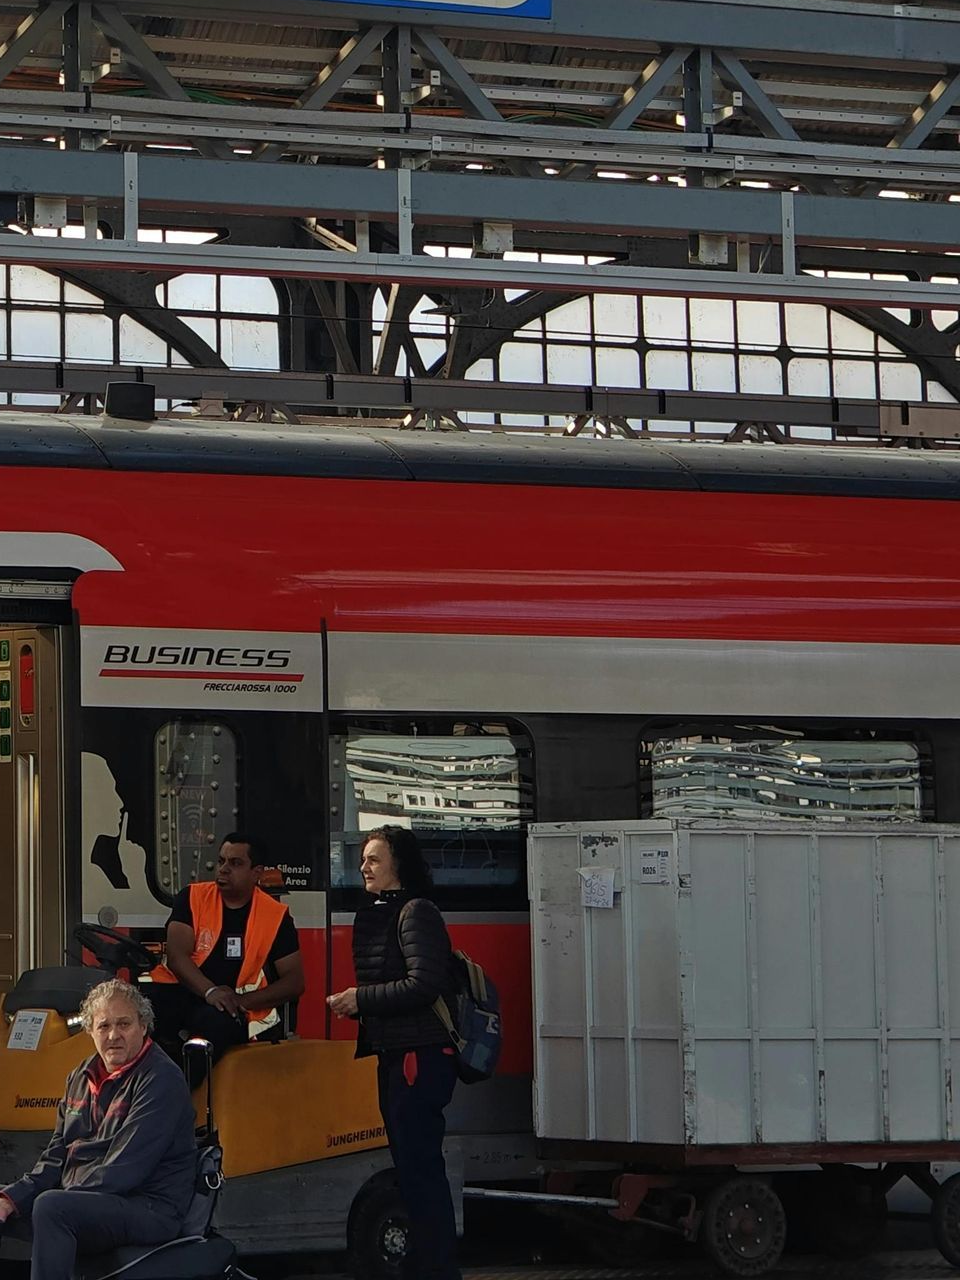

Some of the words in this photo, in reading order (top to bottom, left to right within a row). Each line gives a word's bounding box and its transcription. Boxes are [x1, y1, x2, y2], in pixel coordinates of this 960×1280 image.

[103, 644, 292, 668] BUSINESS
[203, 683, 271, 693] FRECCIAROSSA
[273, 684, 297, 693] 1000
[277, 863, 311, 874] Silenzio
[285, 876, 307, 886] Area
